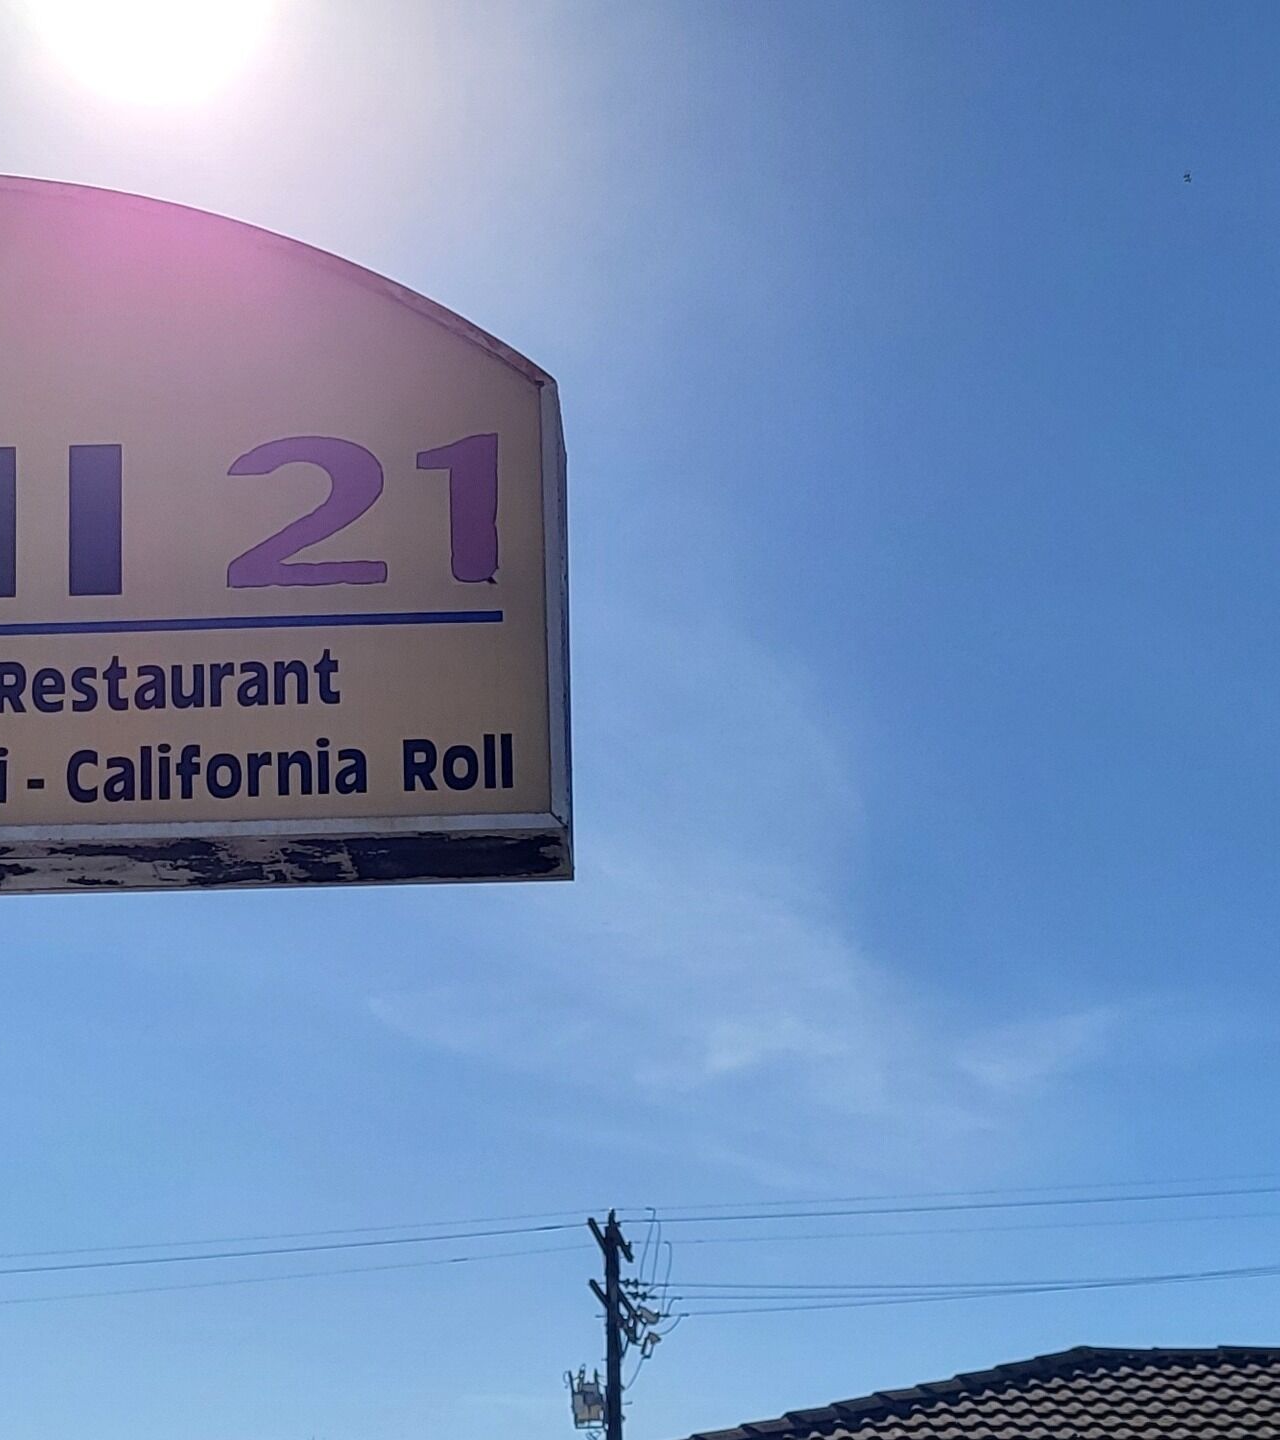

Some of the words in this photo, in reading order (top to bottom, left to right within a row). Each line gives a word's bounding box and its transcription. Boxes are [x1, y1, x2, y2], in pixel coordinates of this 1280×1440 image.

[226, 433, 499, 588] 21
[65, 736, 368, 804] California
[403, 732, 515, 792] Roll
